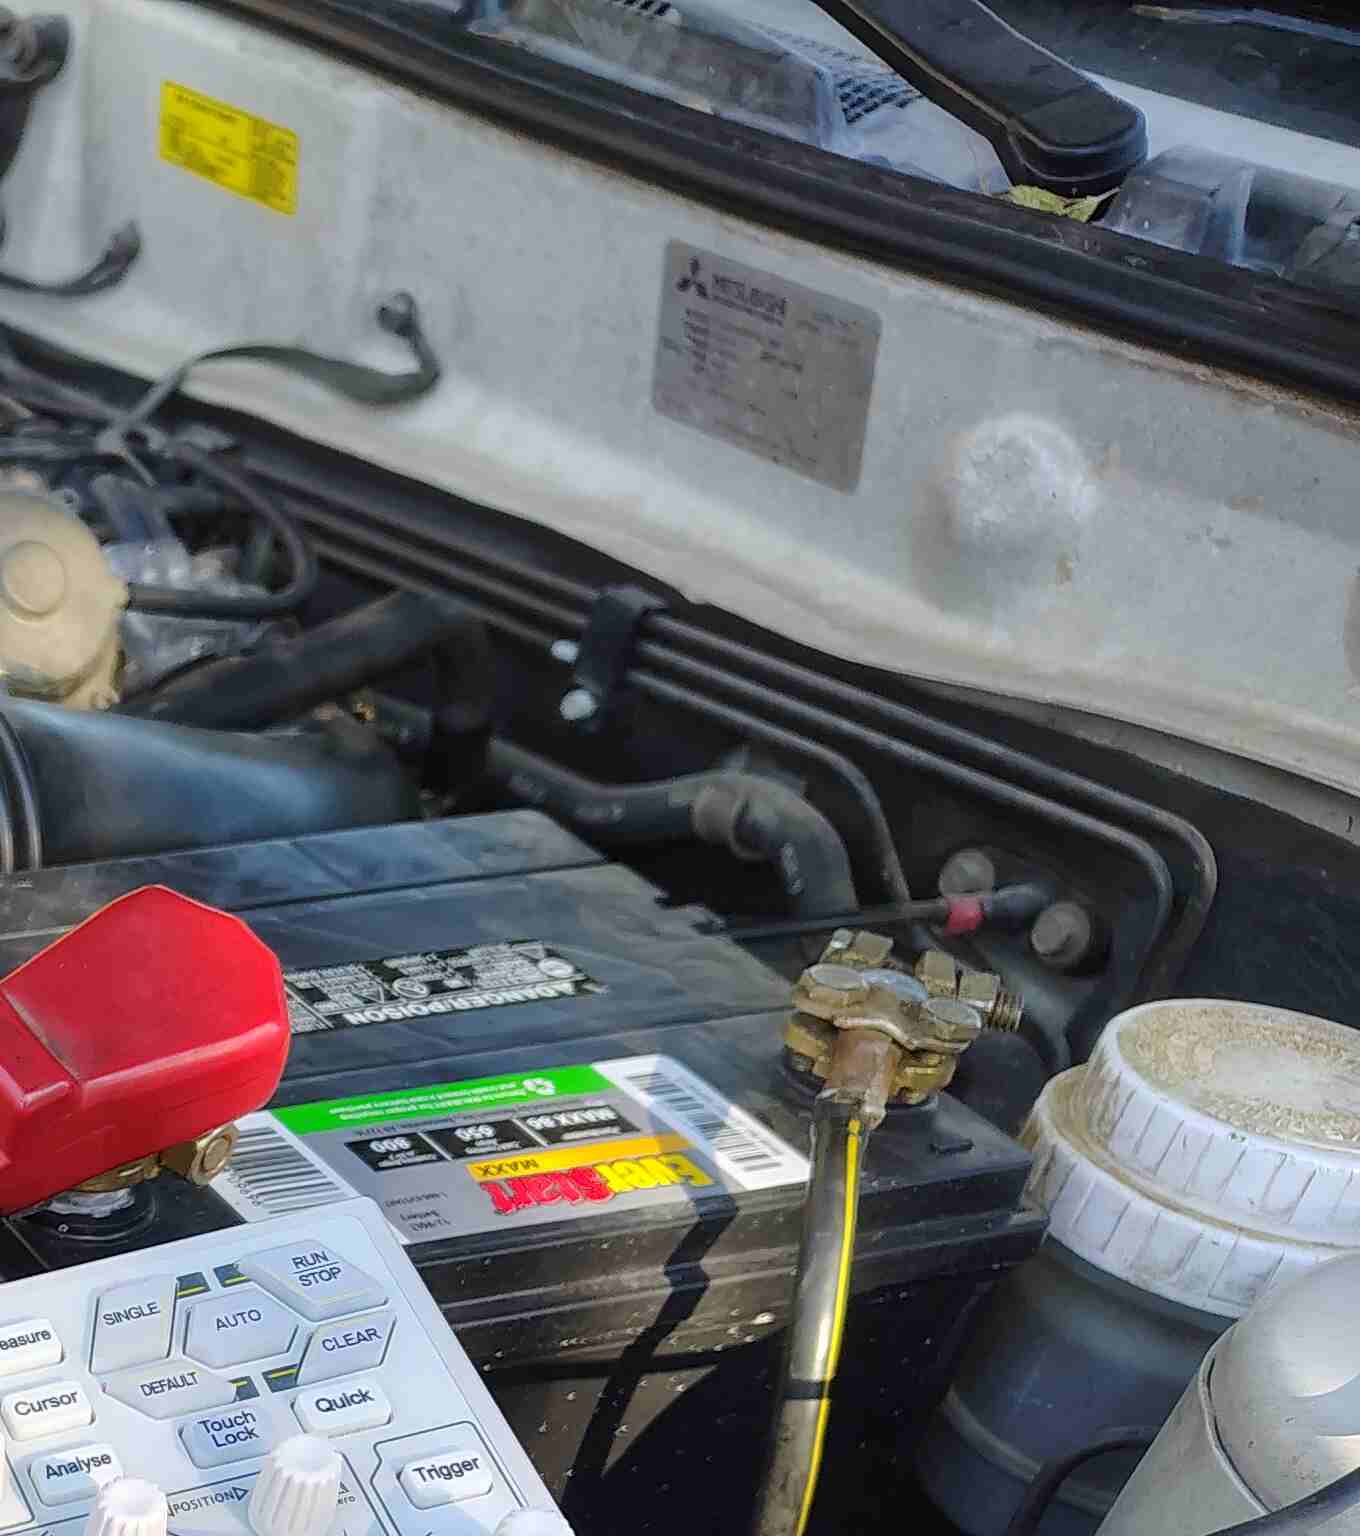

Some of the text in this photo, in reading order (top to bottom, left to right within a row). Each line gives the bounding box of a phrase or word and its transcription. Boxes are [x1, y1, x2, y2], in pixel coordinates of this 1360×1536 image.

[478, 1157, 538, 1176] MAXX
[480, 1151, 714, 1216] EverStart
[293, 1251, 329, 1270] RUN
[298, 1267, 342, 1287] STOP
[103, 1302, 160, 1326] SINGLE
[215, 1309, 262, 1331] AUTO
[322, 1328, 382, 1353] CLEAR
[140, 1371, 199, 1397] DEFAULT
[14, 1389, 78, 1416] Cursor
[315, 1389, 375, 1413] Quick
[198, 1411, 256, 1436] Touch
[212, 1426, 260, 1449] Lock
[46, 1451, 112, 1479] Analyse
[412, 1456, 480, 1487] Trigger
[173, 1491, 234, 1516] POSITION
